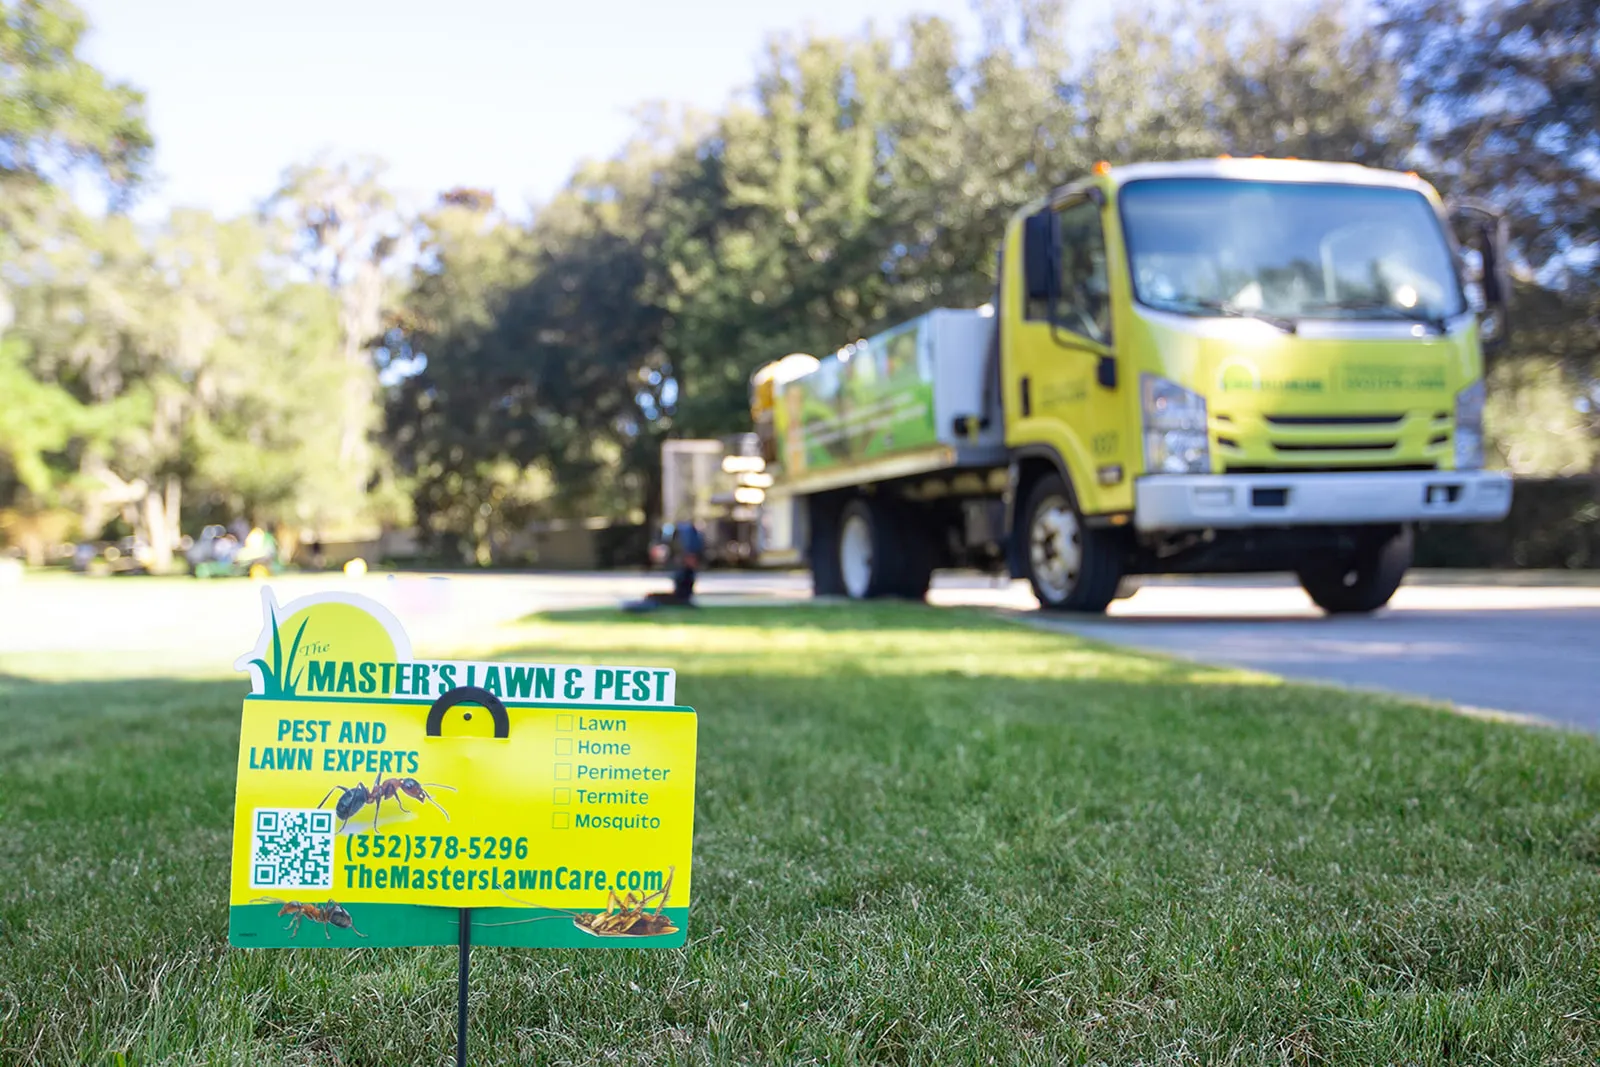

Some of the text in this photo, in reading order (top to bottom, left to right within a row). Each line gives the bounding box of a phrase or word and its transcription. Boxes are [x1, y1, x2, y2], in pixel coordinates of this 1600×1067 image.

[299, 641, 330, 656] The
[307, 660, 457, 696] MASTER'S
[563, 668, 585, 700] &
[594, 669, 670, 702] PEST
[277, 719, 387, 744] PEST AND
[579, 716, 627, 731] Lawn
[578, 740, 631, 755] Home
[249, 747, 419, 773] LAWN EXPERTS
[577, 764, 671, 781] Perimeter
[577, 789, 649, 805] Termite
[575, 814, 661, 831] Mosquito
[346, 833, 529, 862] (352)378-5296
[344, 864, 664, 891] TheMastersLawnCare.com
